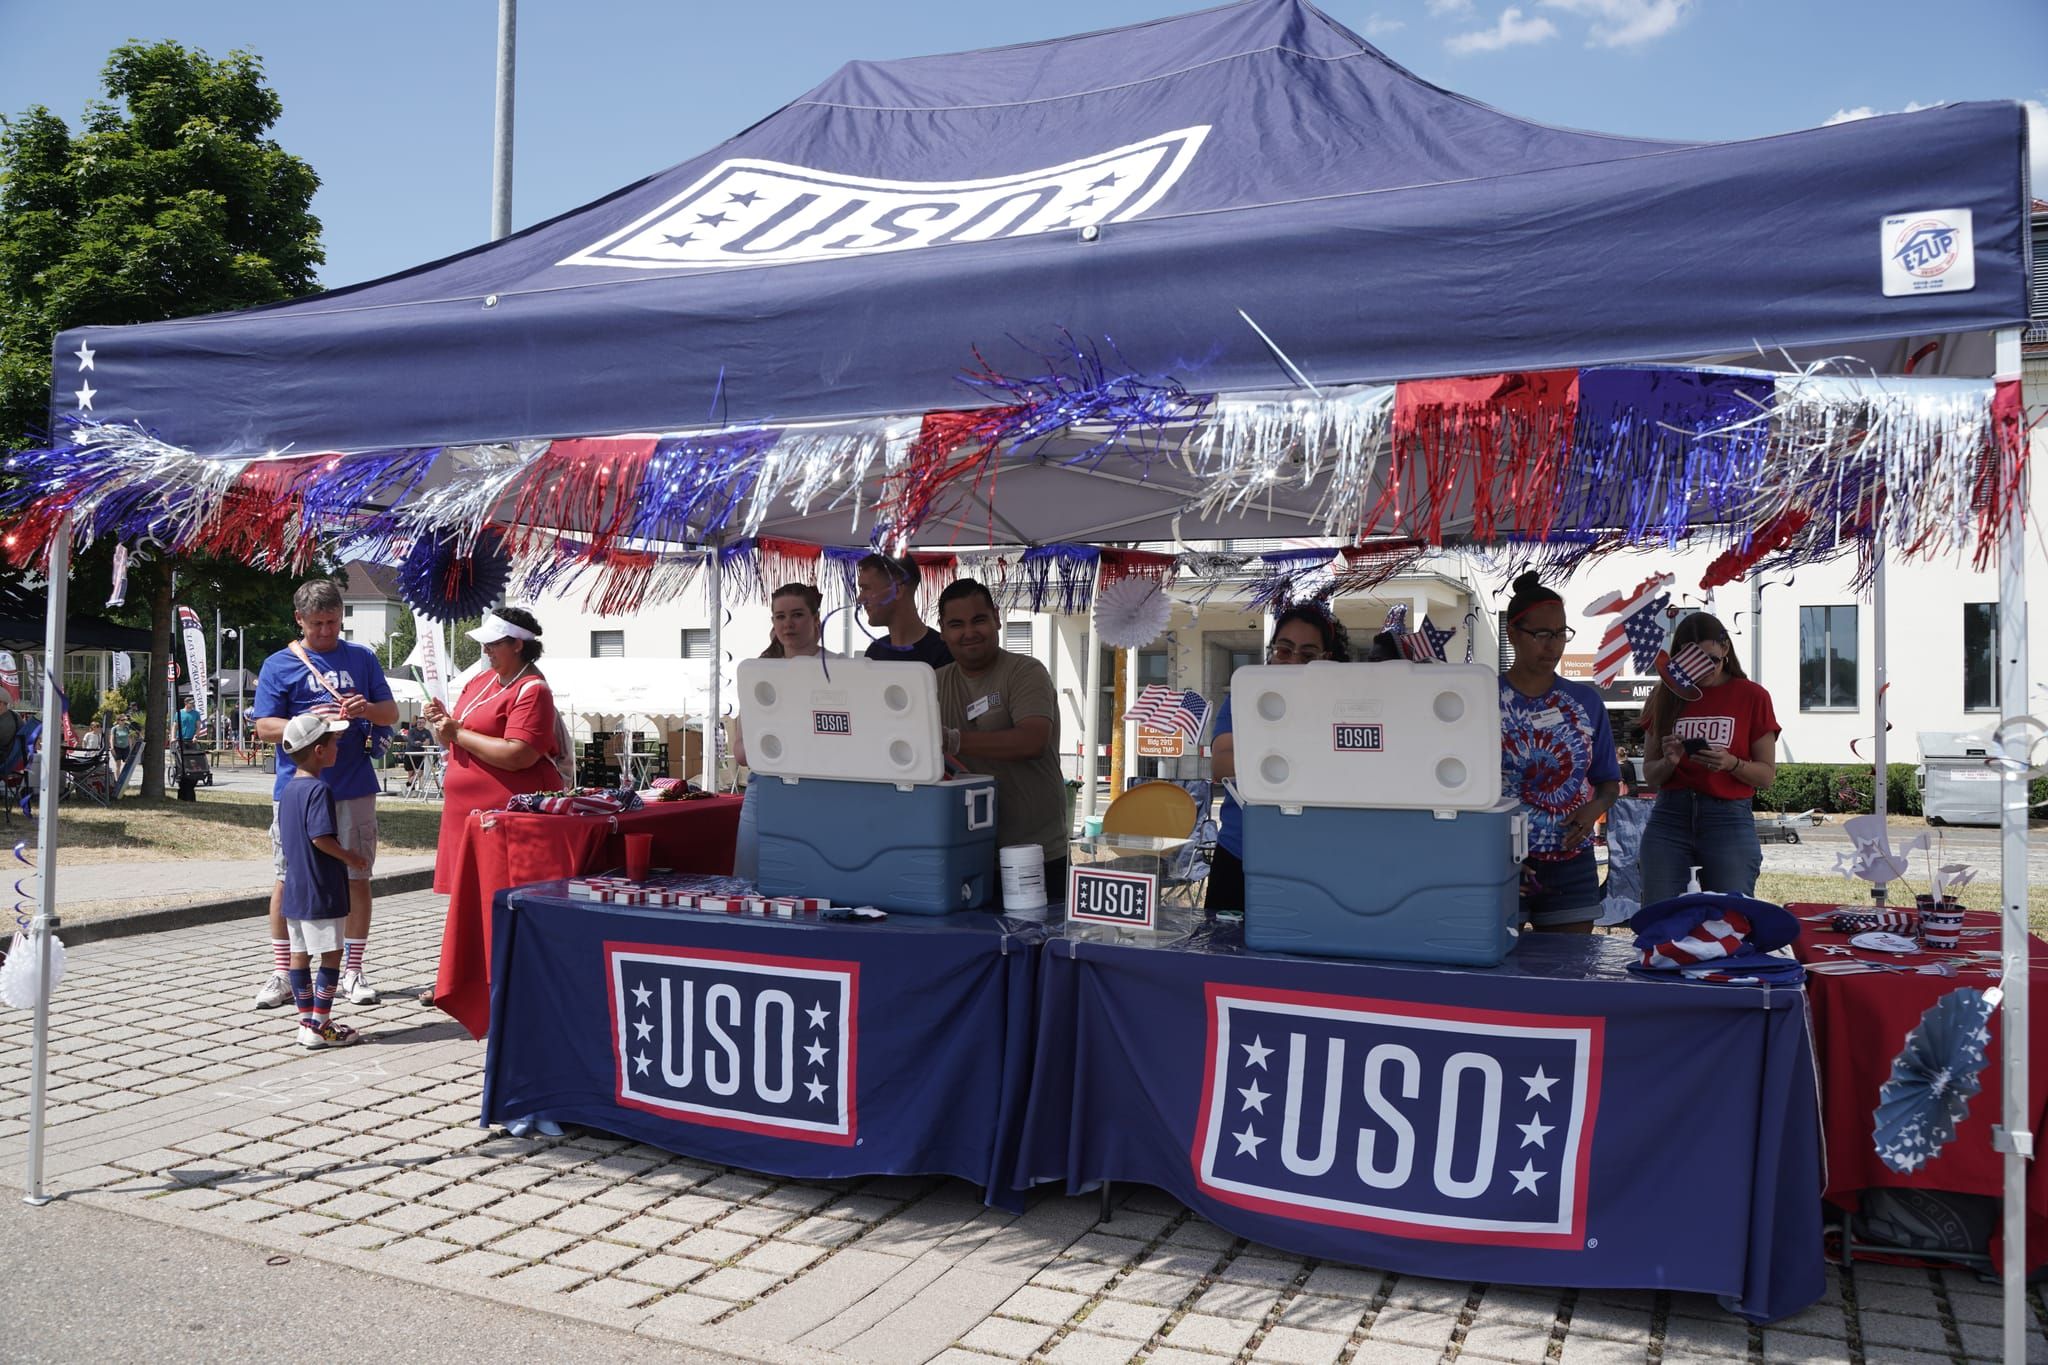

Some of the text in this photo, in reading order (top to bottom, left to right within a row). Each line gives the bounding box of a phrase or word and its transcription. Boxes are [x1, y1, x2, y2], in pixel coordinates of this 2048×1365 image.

[720, 184, 1064, 254] USO
[307, 670, 355, 692] USA
[821, 714, 844, 732] USO
[1684, 721, 1720, 741] USO
[1344, 728, 1373, 748] USO
[1140, 746, 1162, 754] Housing
[1089, 880, 1134, 916] USO
[660, 977, 795, 1104] USO
[1280, 1032, 1504, 1199] USO
